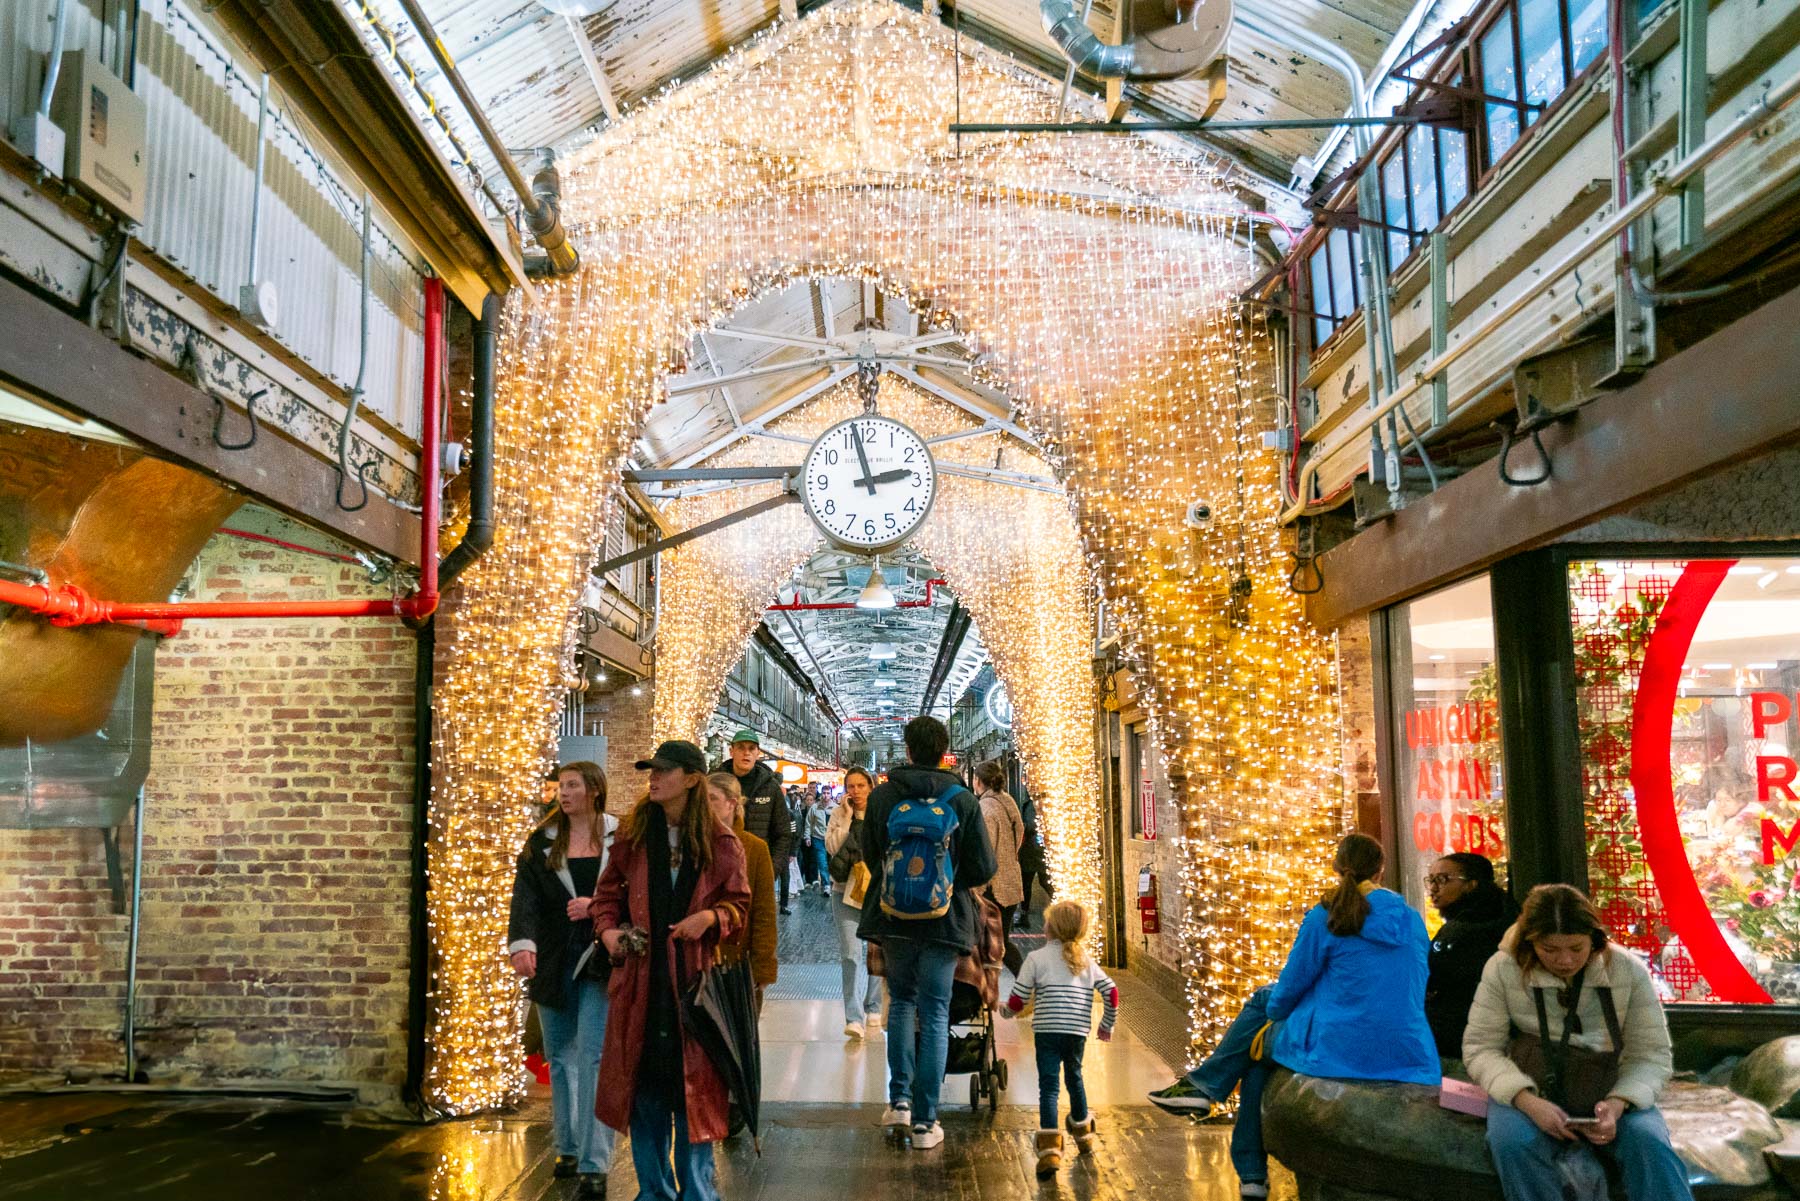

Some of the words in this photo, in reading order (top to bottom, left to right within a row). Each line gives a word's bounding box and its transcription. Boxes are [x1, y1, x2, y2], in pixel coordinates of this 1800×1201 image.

[844, 433, 854, 450] 11
[861, 427, 877, 443] 12
[890, 432, 894, 448] 1
[825, 449, 838, 466] 10
[904, 447, 915, 463] 2
[817, 474, 828, 491] 9
[911, 472, 922, 488] 3
[824, 499, 836, 515] 8
[903, 497, 917, 513] 4
[845, 514, 857, 530] 7
[864, 519, 876, 536] 6
[884, 513, 896, 529] 5
[1751, 691, 1800, 739] P
[1405, 699, 1500, 750] UNIQUE
[1417, 759, 1492, 800] ASIAN
[1413, 811, 1504, 859] GOODS
